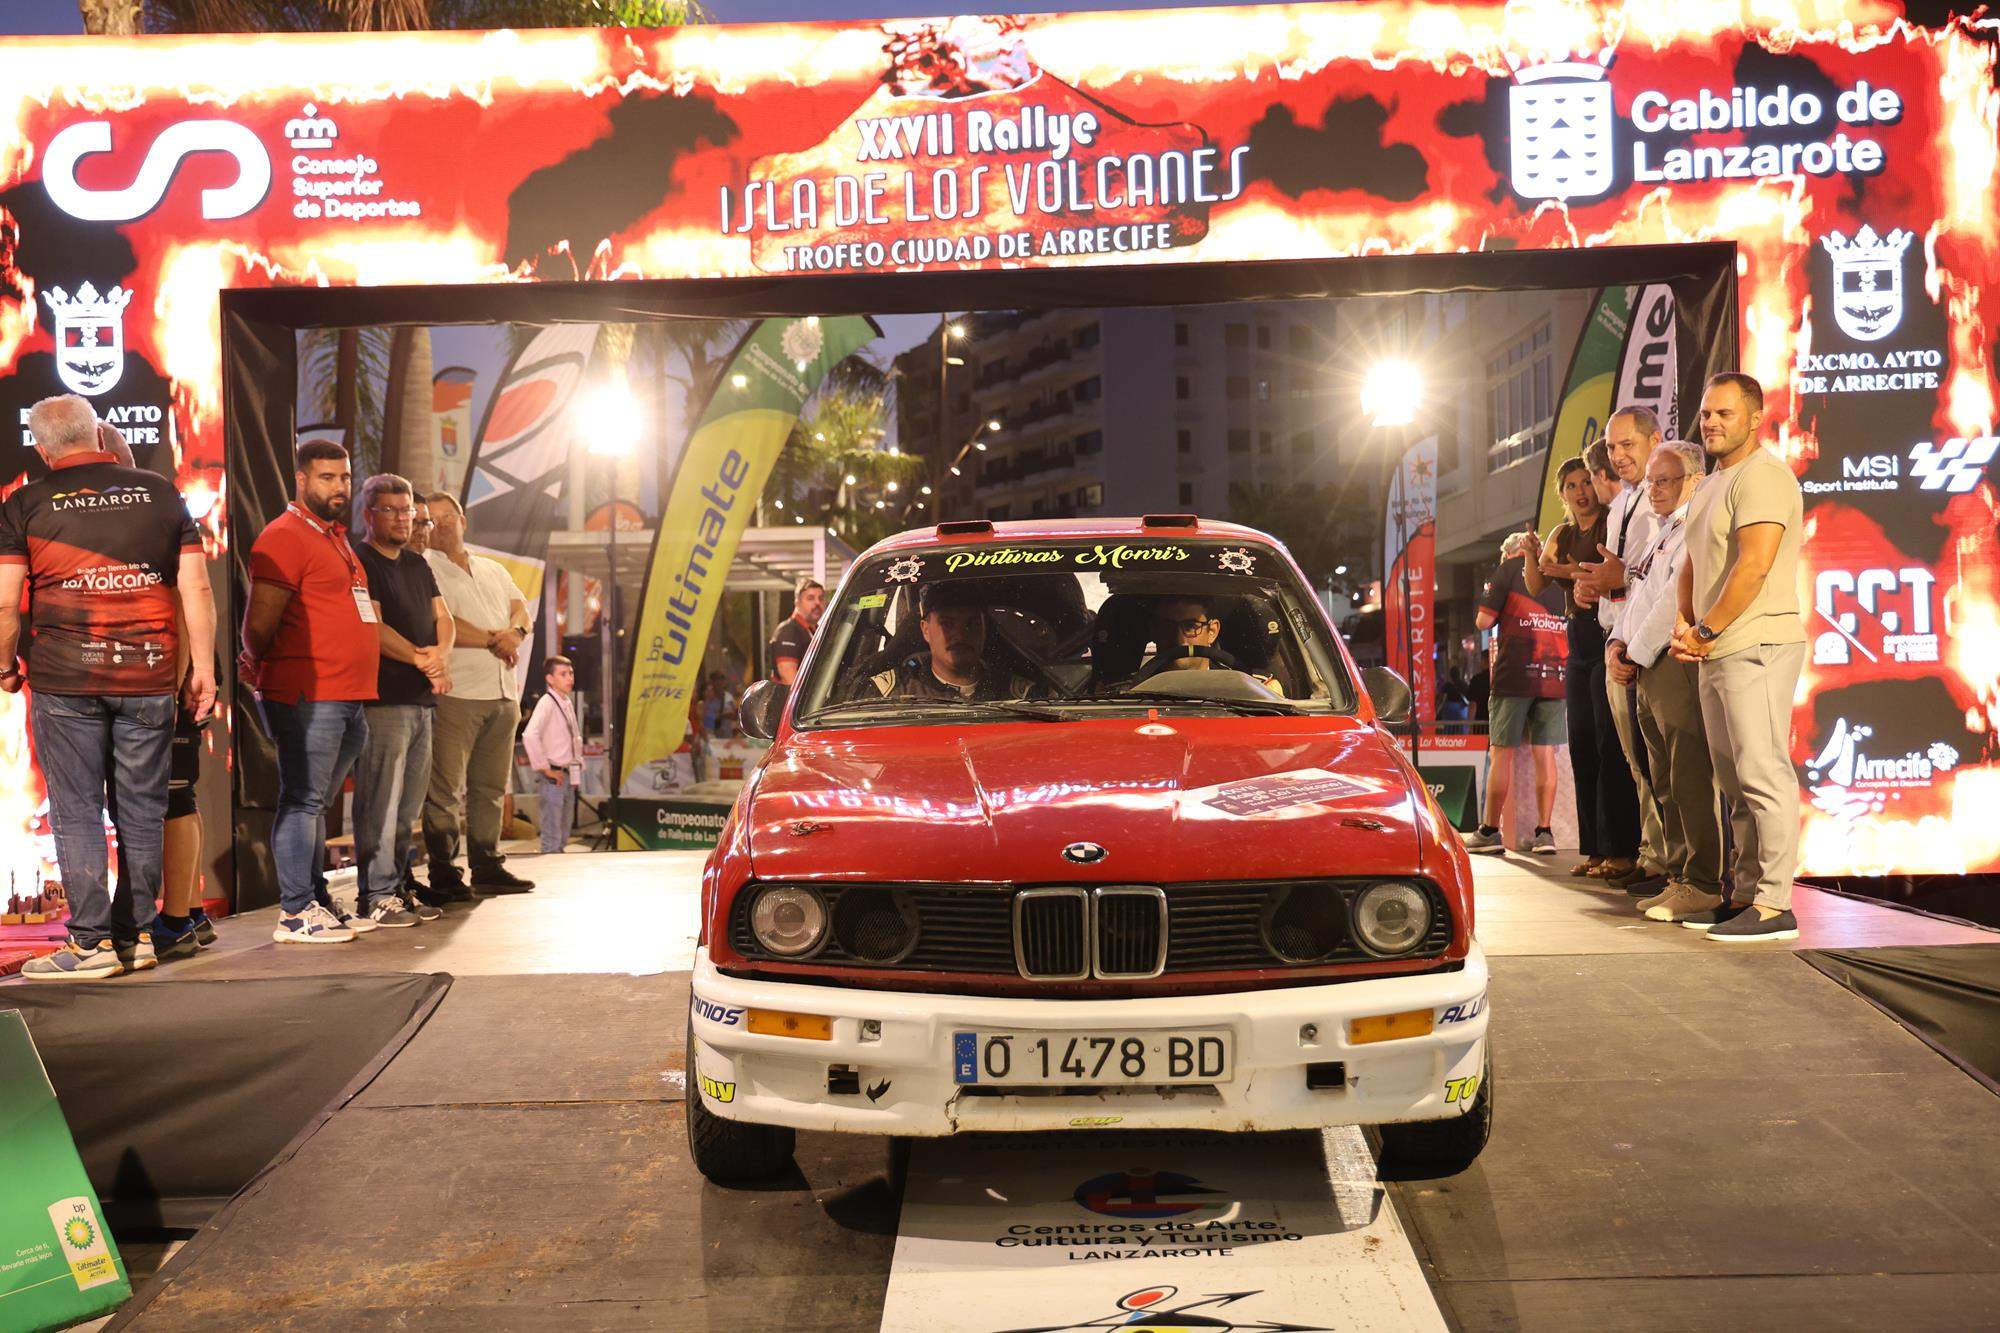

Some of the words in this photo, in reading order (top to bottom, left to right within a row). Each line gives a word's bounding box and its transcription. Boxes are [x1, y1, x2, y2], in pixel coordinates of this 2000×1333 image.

[1631, 84, 1822, 132] Cabildo
[1837, 80, 1900, 122] de
[856, 113, 953, 161] XXVII
[967, 105, 1097, 160] Rallye
[292, 154, 377, 177] Consejo
[1633, 133, 1882, 181] Lanzarote
[293, 177, 383, 199] Superior
[721, 180, 818, 233] ISLA
[834, 171, 889, 226] DE
[905, 166, 989, 222] LOS
[1004, 146, 1250, 214] VOLCANES
[293, 199, 321, 218] de
[325, 199, 421, 221] Deportes
[785, 242, 884, 271] TROFEO
[891, 236, 990, 265] CIUDAD
[999, 232, 1030, 258] DE
[1041, 223, 1171, 255] ARRECIFE
[1796, 353, 1880, 371] EXCMO.
[1883, 350, 1941, 368] AYTO
[1798, 377, 1827, 394] DE
[1831, 372, 1938, 392] ARRECIFE
[105, 406, 161, 422] AYTO
[22, 430, 35, 446] D
[1803, 480, 1842, 493] Sport
[1844, 479, 1898, 491] Institute
[52, 493, 152, 511] LANZAROTE
[662, 449, 749, 666] ultimate
[945, 547, 1064, 573] Pinturas
[1075, 545, 1191, 569] Monri's
[1855, 752, 1932, 779] Arrecife
[657, 808, 726, 828] Campeonato
[961, 1064, 971, 1076] E
[1036, 1037, 1146, 1078] 1478
[1168, 1037, 1224, 1077] BD
[73, 1203, 86, 1213] bp
[1007, 1222, 1144, 1236] Centros
[1153, 1220, 1187, 1232] de
[1206, 1220, 1287, 1232] Arte,
[995, 1233, 1126, 1248] Cultura
[1136, 1234, 1154, 1247] y
[1167, 1231, 1303, 1244] Turismo
[1069, 1248, 1234, 1261] LANZAROTE
